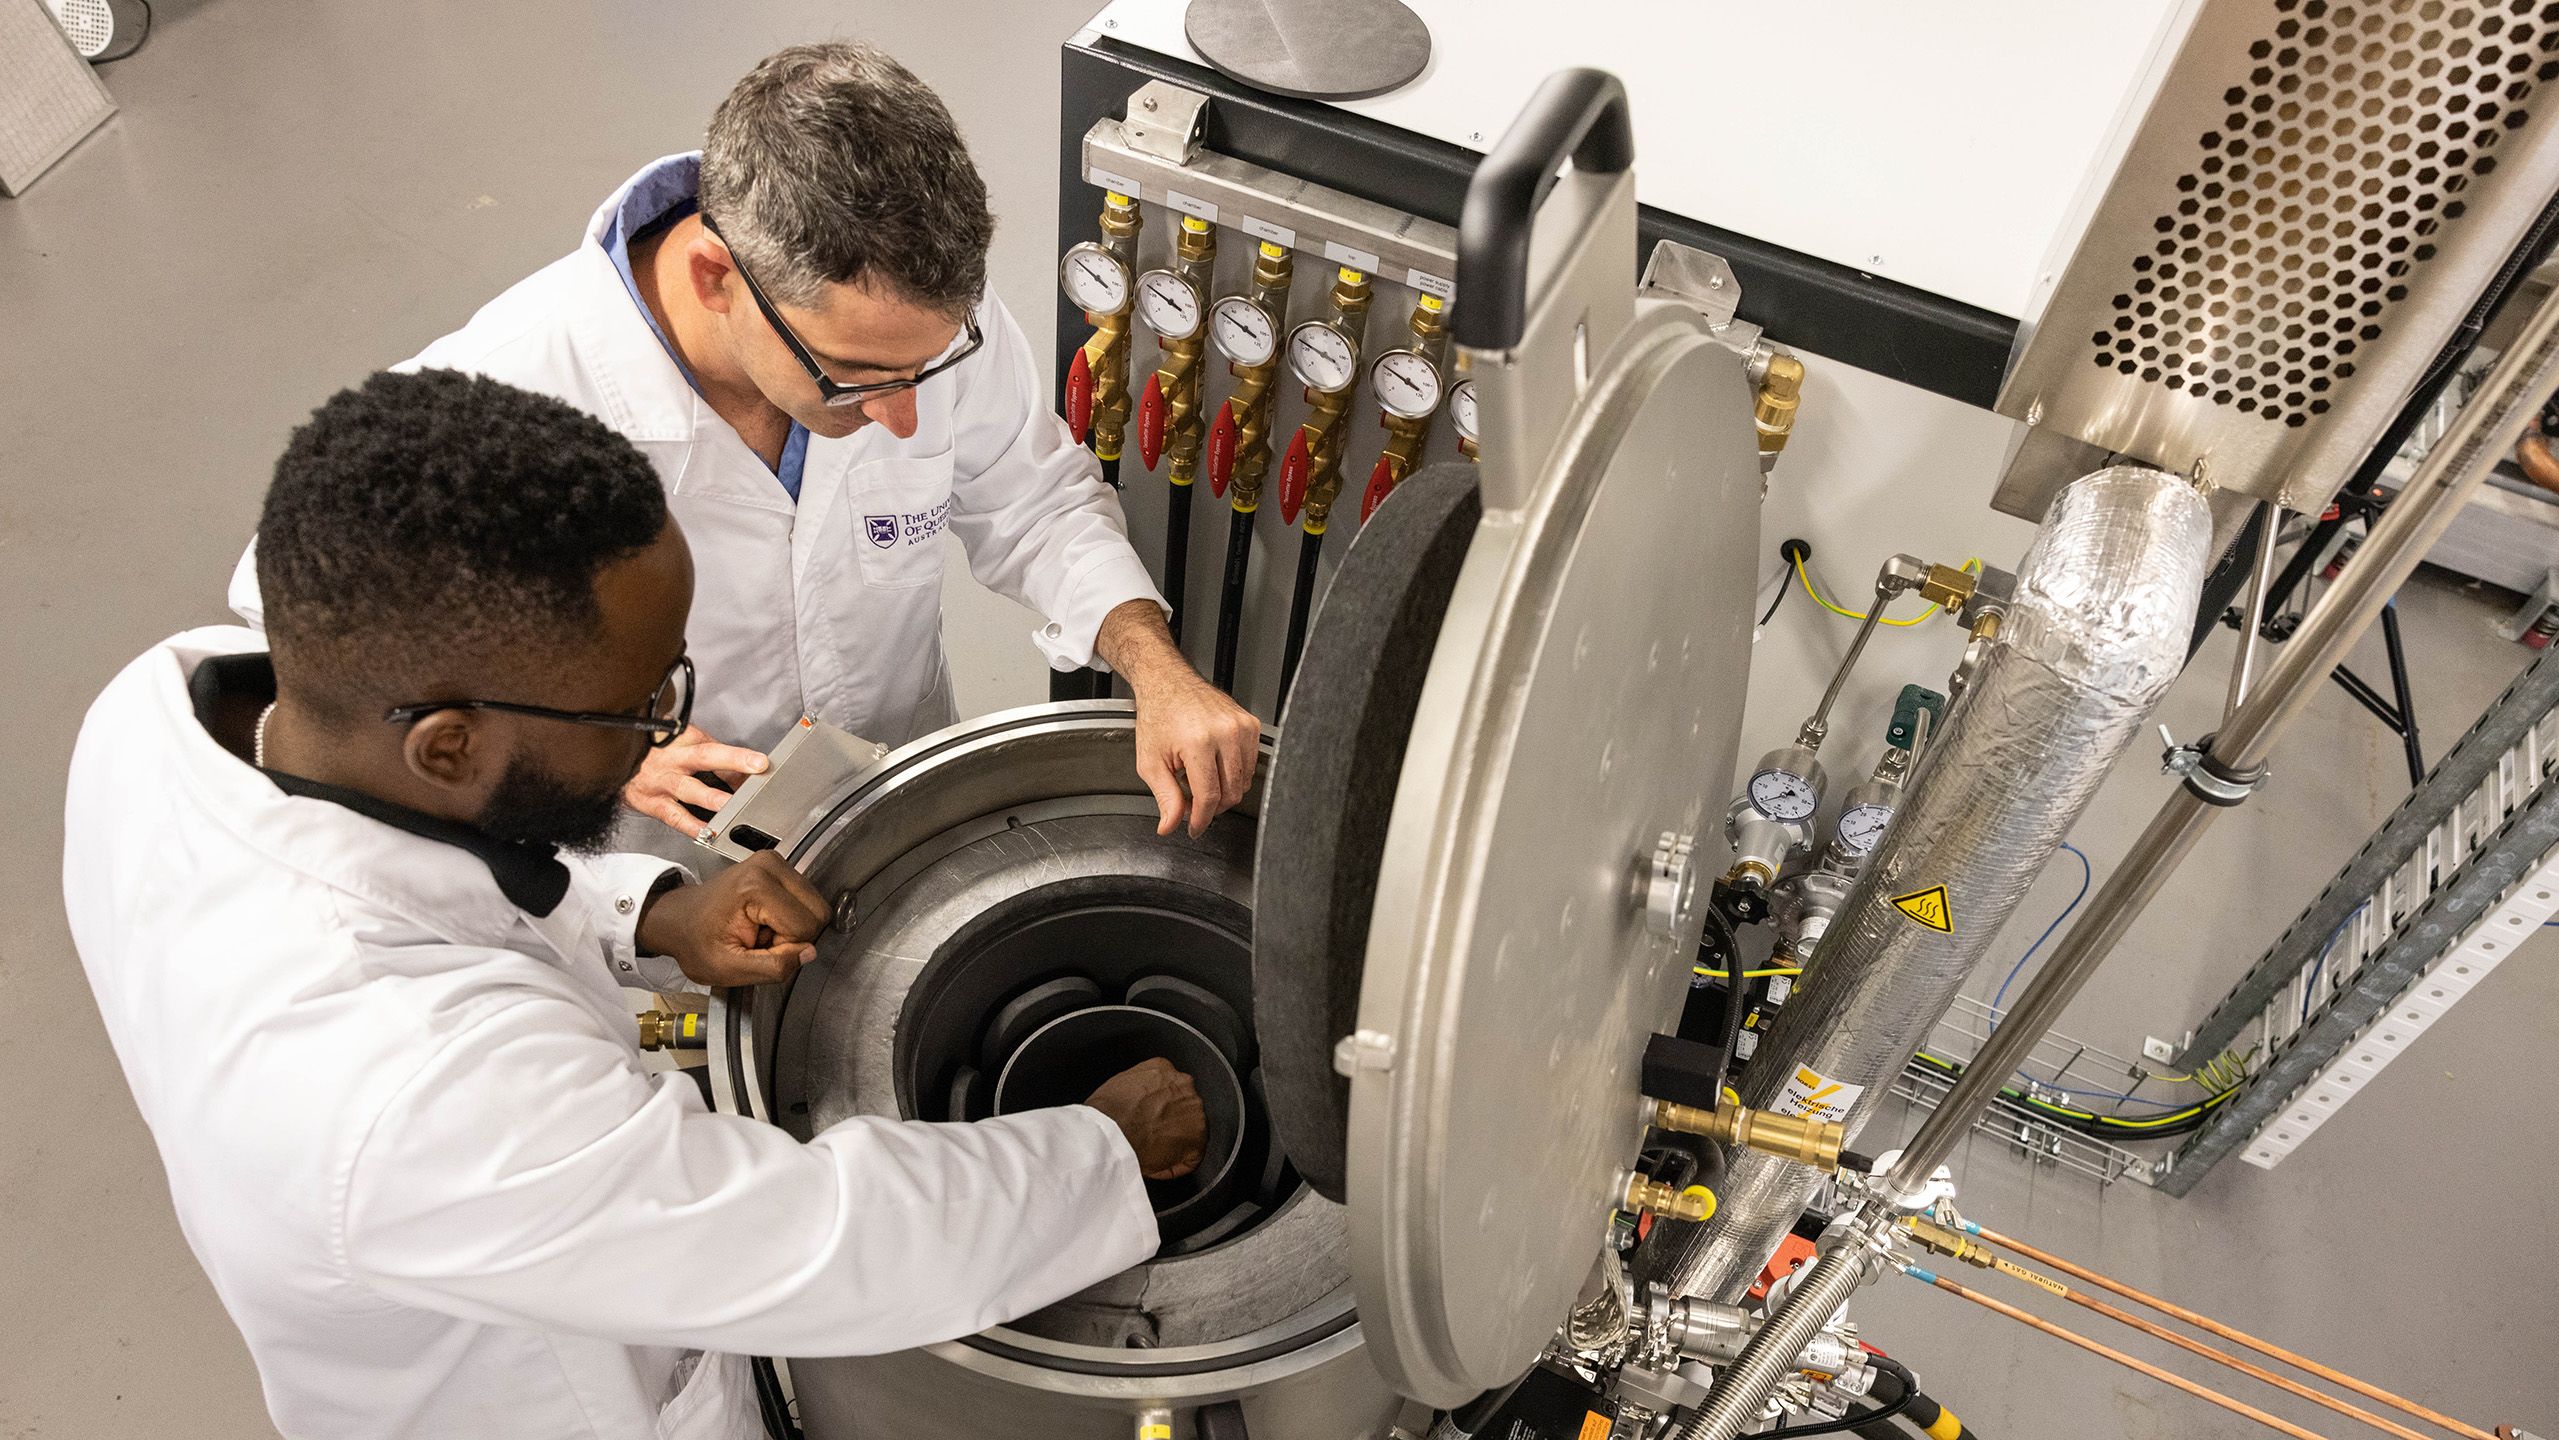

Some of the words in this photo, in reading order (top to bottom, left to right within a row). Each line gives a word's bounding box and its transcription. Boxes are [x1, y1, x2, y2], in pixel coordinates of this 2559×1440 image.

[1182, 201, 1202, 210] chamber
[1258, 226, 1279, 236] chamber
[1419, 275, 1433, 284] power
[1419, 281, 1434, 289] power
[902, 512, 928, 525] THE
[905, 526, 922, 536] OF
[1787, 1088, 1845, 1114] elektrische
[1781, 1107, 1797, 1118] ele
[1789, 1097, 1833, 1119] Heizung
[2011, 1265, 2027, 1276] GAS
[2030, 1271, 2064, 1291] NATURAL
